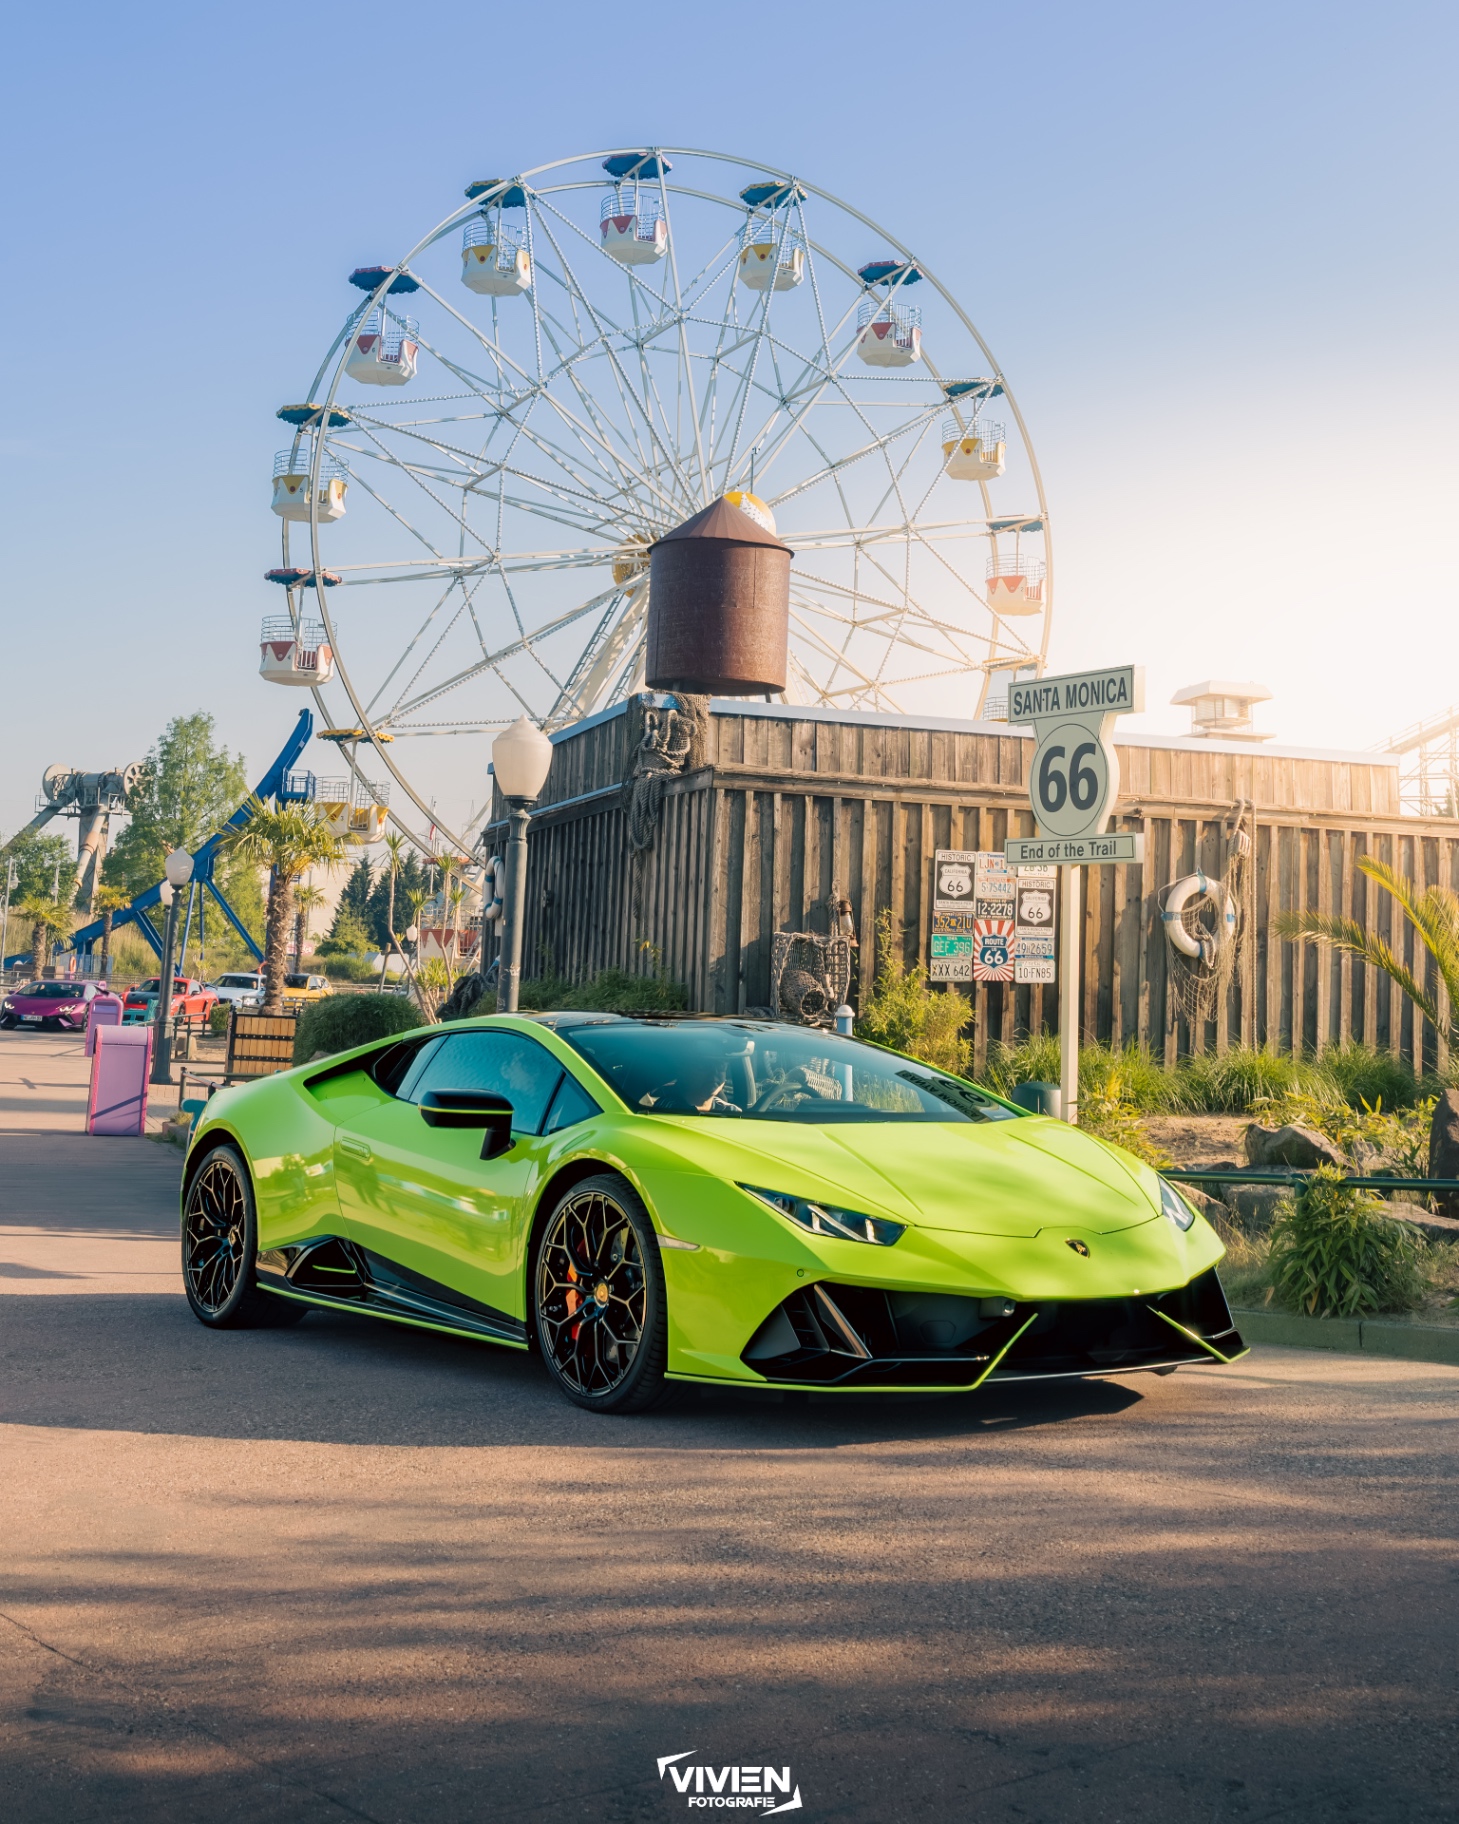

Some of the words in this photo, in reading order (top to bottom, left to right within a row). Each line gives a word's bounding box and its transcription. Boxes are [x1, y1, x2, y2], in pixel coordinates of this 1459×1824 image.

[1014, 686, 1060, 716] SANTA
[1066, 677, 1128, 710] MONICA
[1038, 742, 1098, 812] 66
[1020, 845, 1043, 860] End
[1048, 843, 1060, 858] of
[1064, 842, 1084, 857] the
[1088, 840, 1116, 856] Trail
[948, 880, 964, 892] 66
[1028, 907, 1043, 919] 66
[935, 916, 949, 928] 352
[954, 942, 970, 953] 396
[984, 950, 1004, 965] 66
[932, 964, 950, 976] XXX
[954, 965, 970, 977] 642
